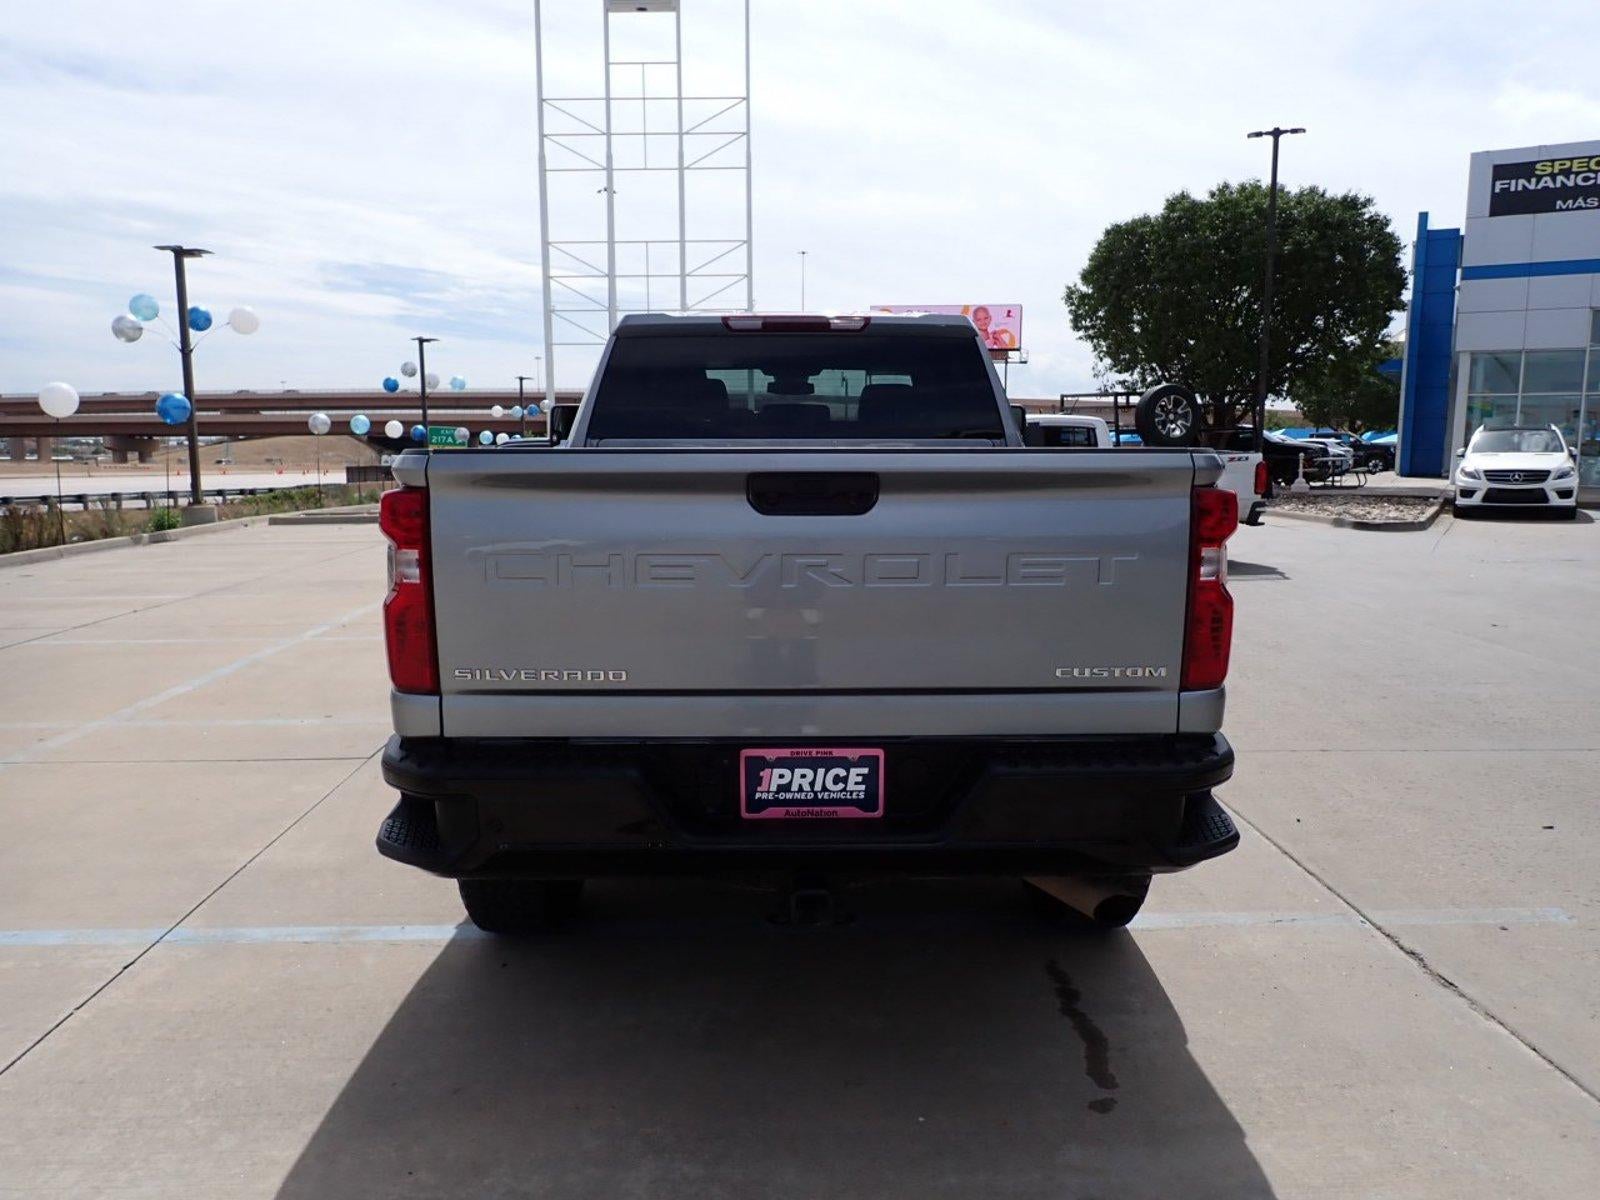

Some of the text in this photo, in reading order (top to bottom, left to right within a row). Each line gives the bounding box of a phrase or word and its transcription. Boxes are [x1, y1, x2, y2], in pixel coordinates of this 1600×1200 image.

[1535, 157, 1600, 175] SPEC
[1555, 196, 1599, 210] MÁS
[483, 553, 1138, 589] CHEVROLET
[453, 669, 628, 682] SILVERADO
[1055, 667, 1168, 678] CUSTOM
[756, 767, 870, 792] 1PRICE
[755, 791, 865, 800] PRE-OWNED VEHICLES
[783, 808, 839, 818] AutoNation
